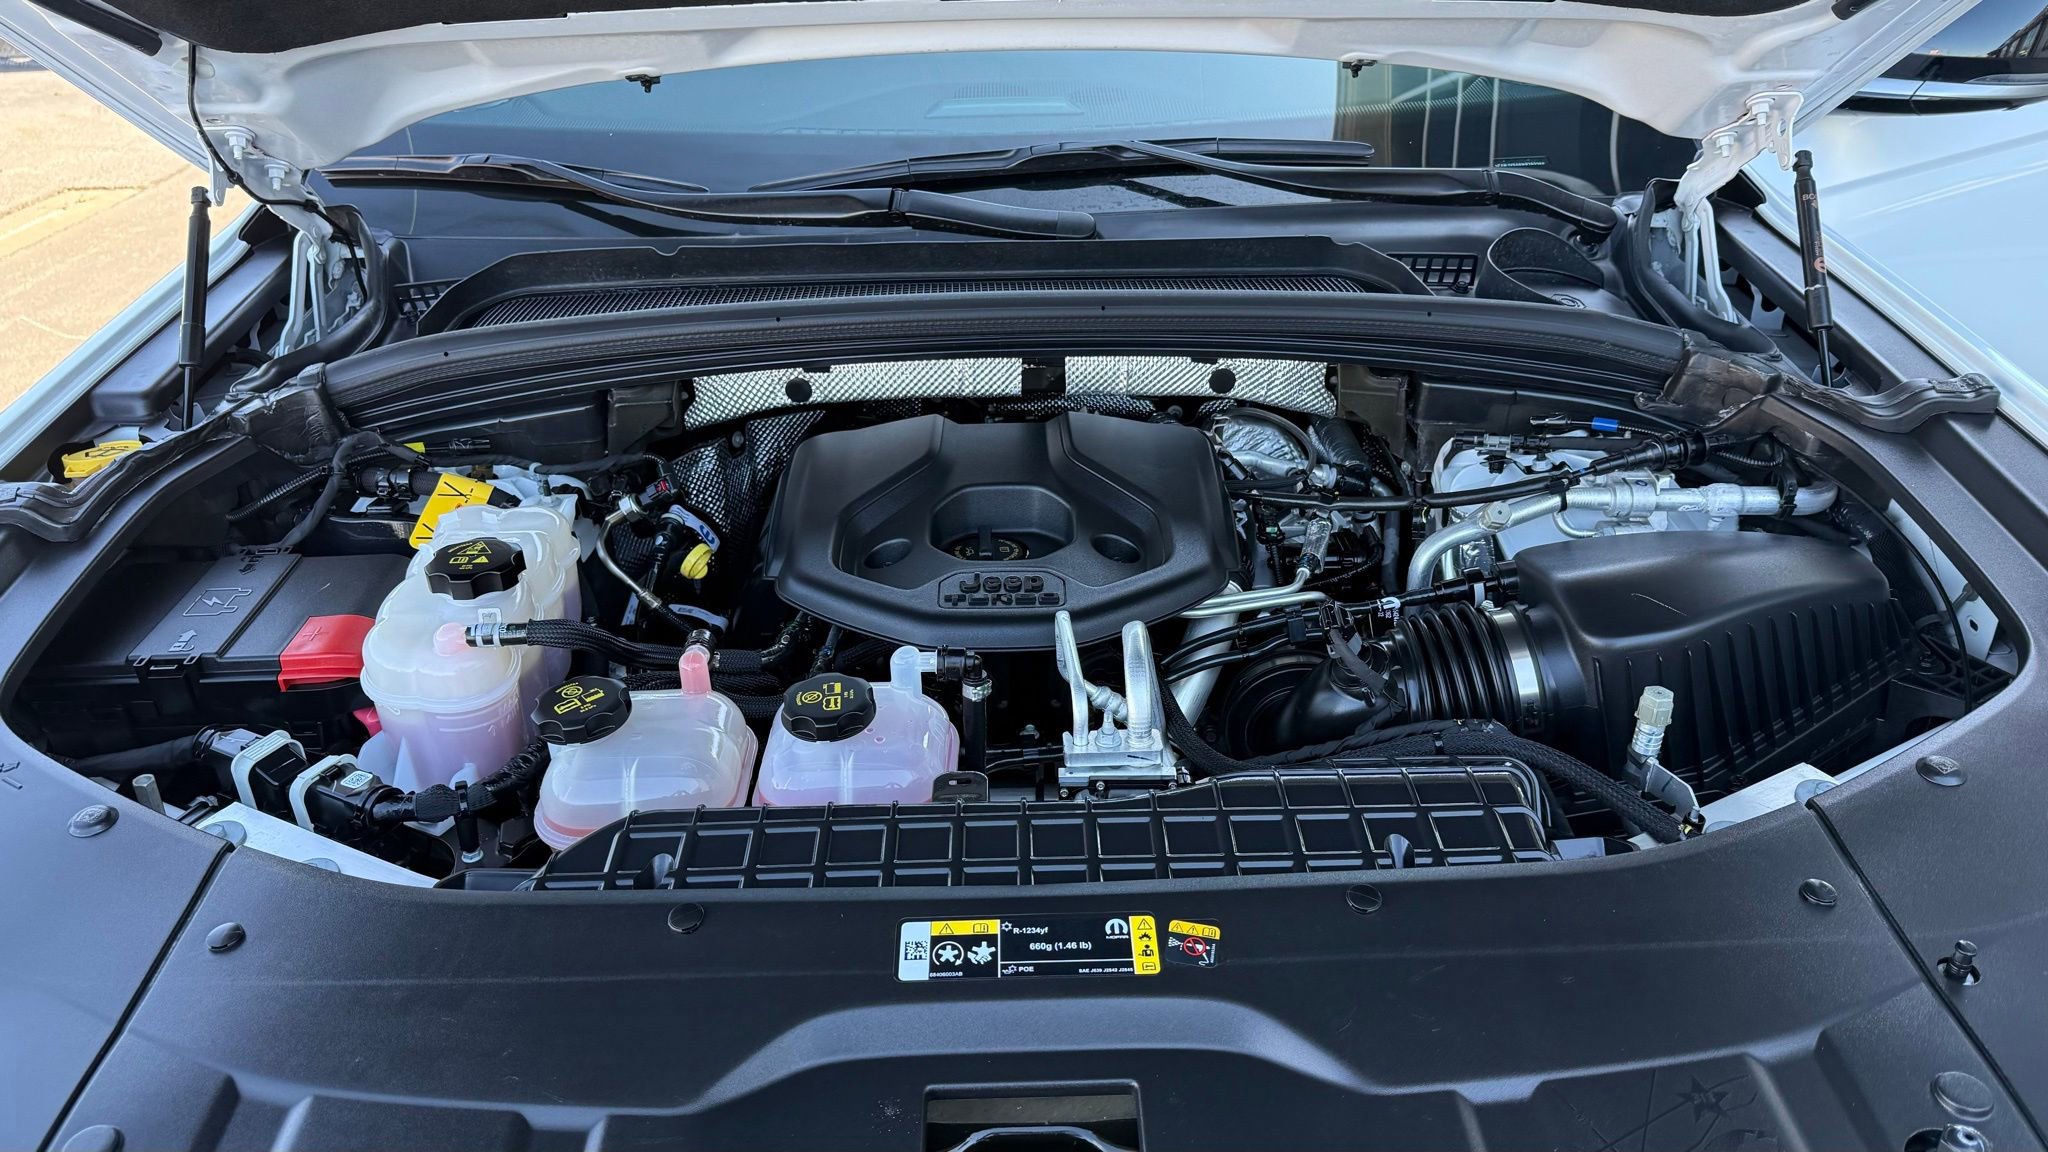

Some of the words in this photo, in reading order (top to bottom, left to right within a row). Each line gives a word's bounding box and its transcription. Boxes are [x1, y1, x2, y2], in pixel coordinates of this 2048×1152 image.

[959, 572, 1044, 593] Jeep
[1013, 927, 1049, 935] R-1234yf
[1029, 942, 1053, 952] 660g
[1054, 941, 1078, 951] (1.46
[1079, 941, 1092, 951] lb)
